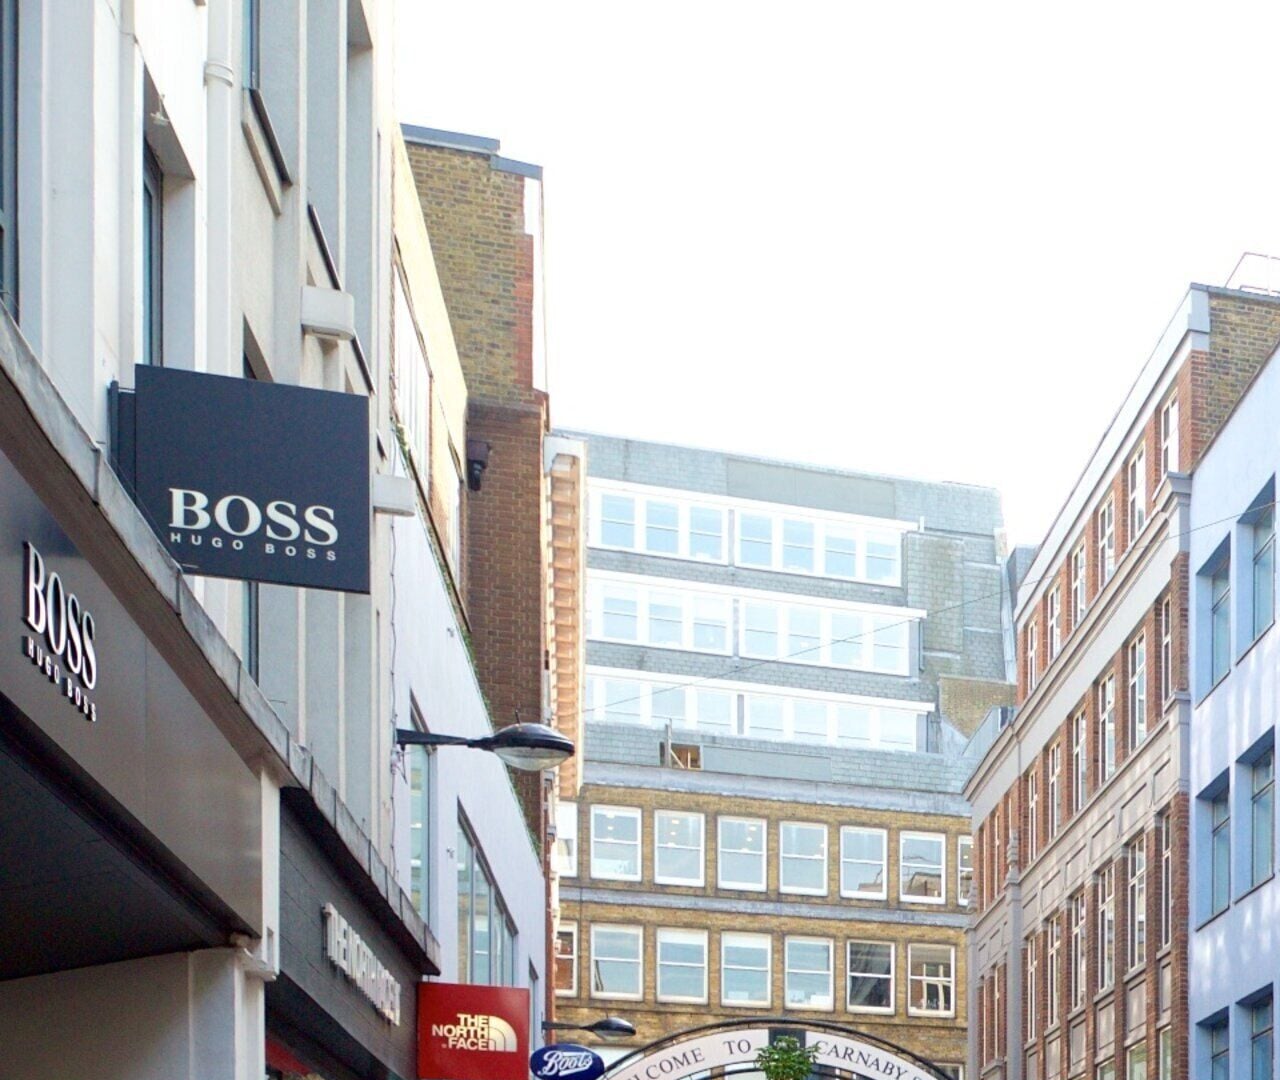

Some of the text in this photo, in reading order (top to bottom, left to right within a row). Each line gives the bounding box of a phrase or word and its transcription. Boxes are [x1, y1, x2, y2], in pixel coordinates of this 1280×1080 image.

[169, 488, 338, 545] BOSS
[170, 532, 337, 561] HUGO BOSS
[24, 541, 97, 690] BOSS
[26, 636, 97, 722] HUGO BOSS
[432, 1024, 488, 1039] NORTH
[456, 1013, 489, 1027] THE
[448, 1037, 488, 1051] FACE
[723, 1039, 752, 1056] TO
[537, 1050, 593, 1077] Boots
